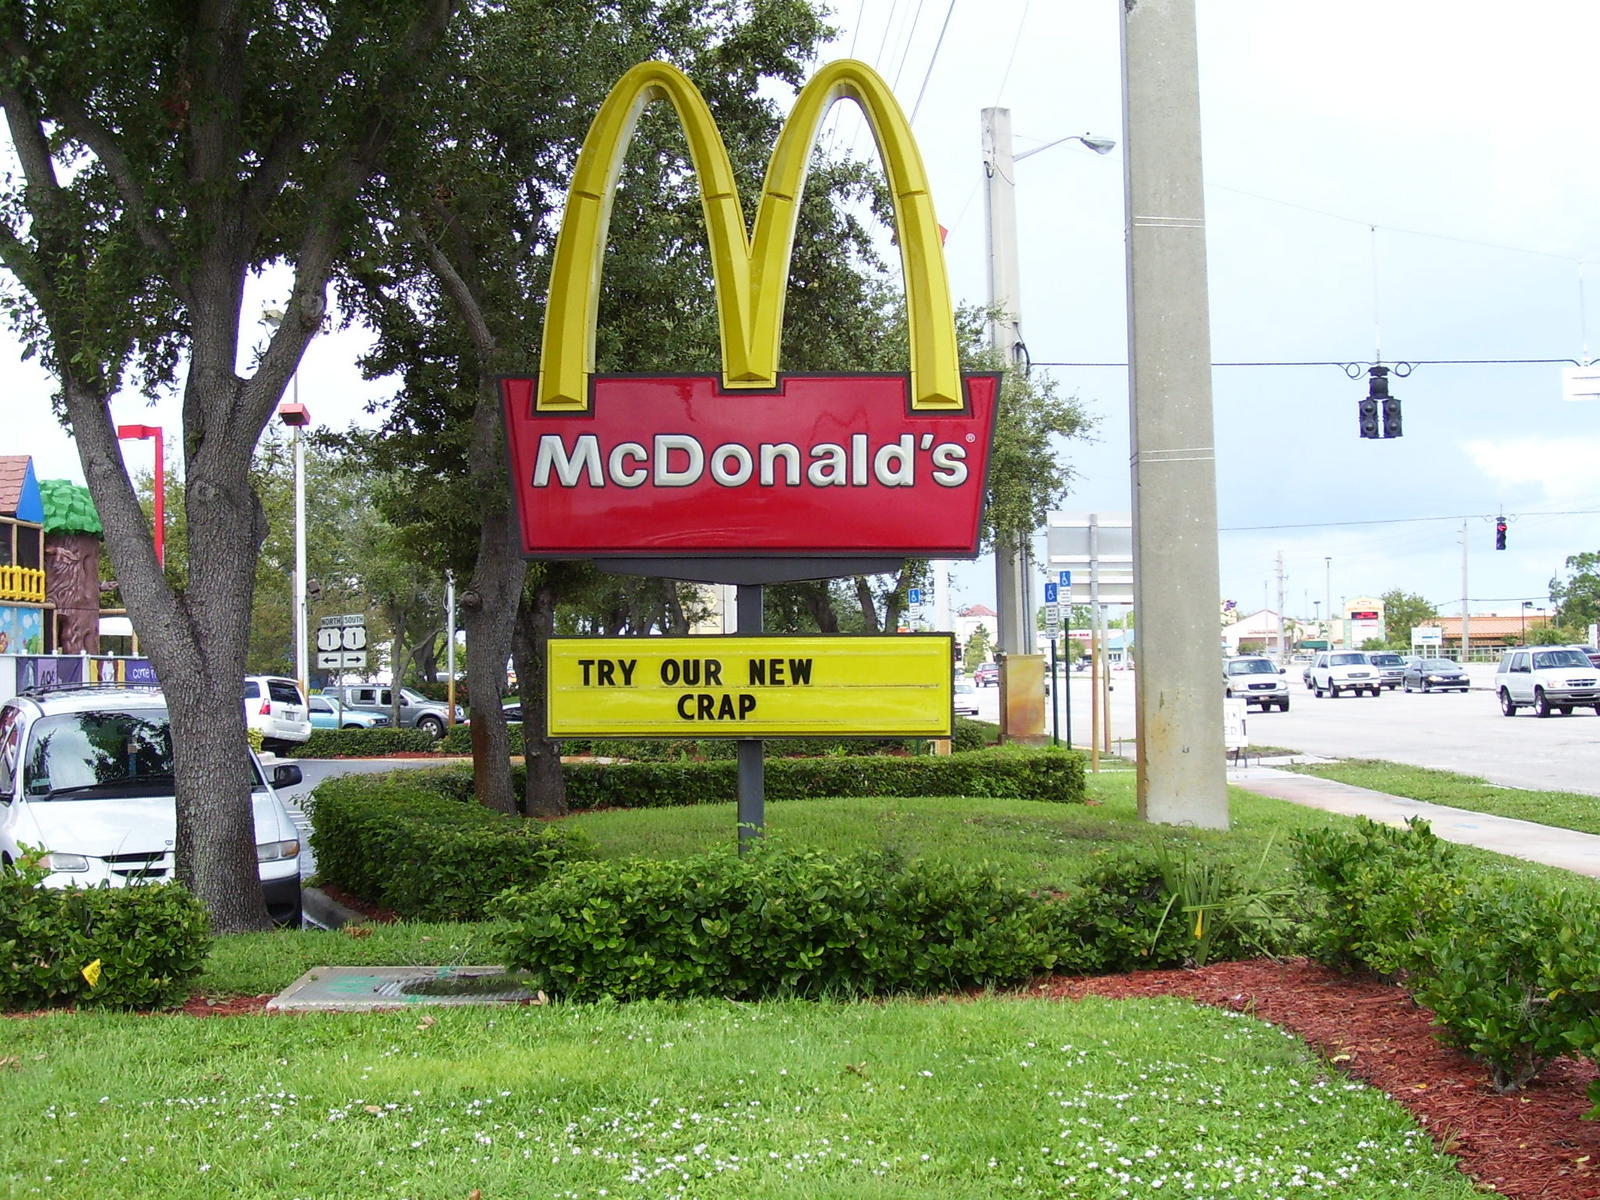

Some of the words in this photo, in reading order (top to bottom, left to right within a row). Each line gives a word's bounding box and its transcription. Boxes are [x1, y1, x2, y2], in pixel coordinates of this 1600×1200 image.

[532, 434, 968, 487] McDonald's
[321, 617, 341, 625] NORTH
[344, 616, 363, 624] SOUTH
[578, 659, 637, 686] TRY
[660, 659, 722, 686] OUR
[749, 659, 813, 685] NEW
[677, 694, 757, 720] CRAP
